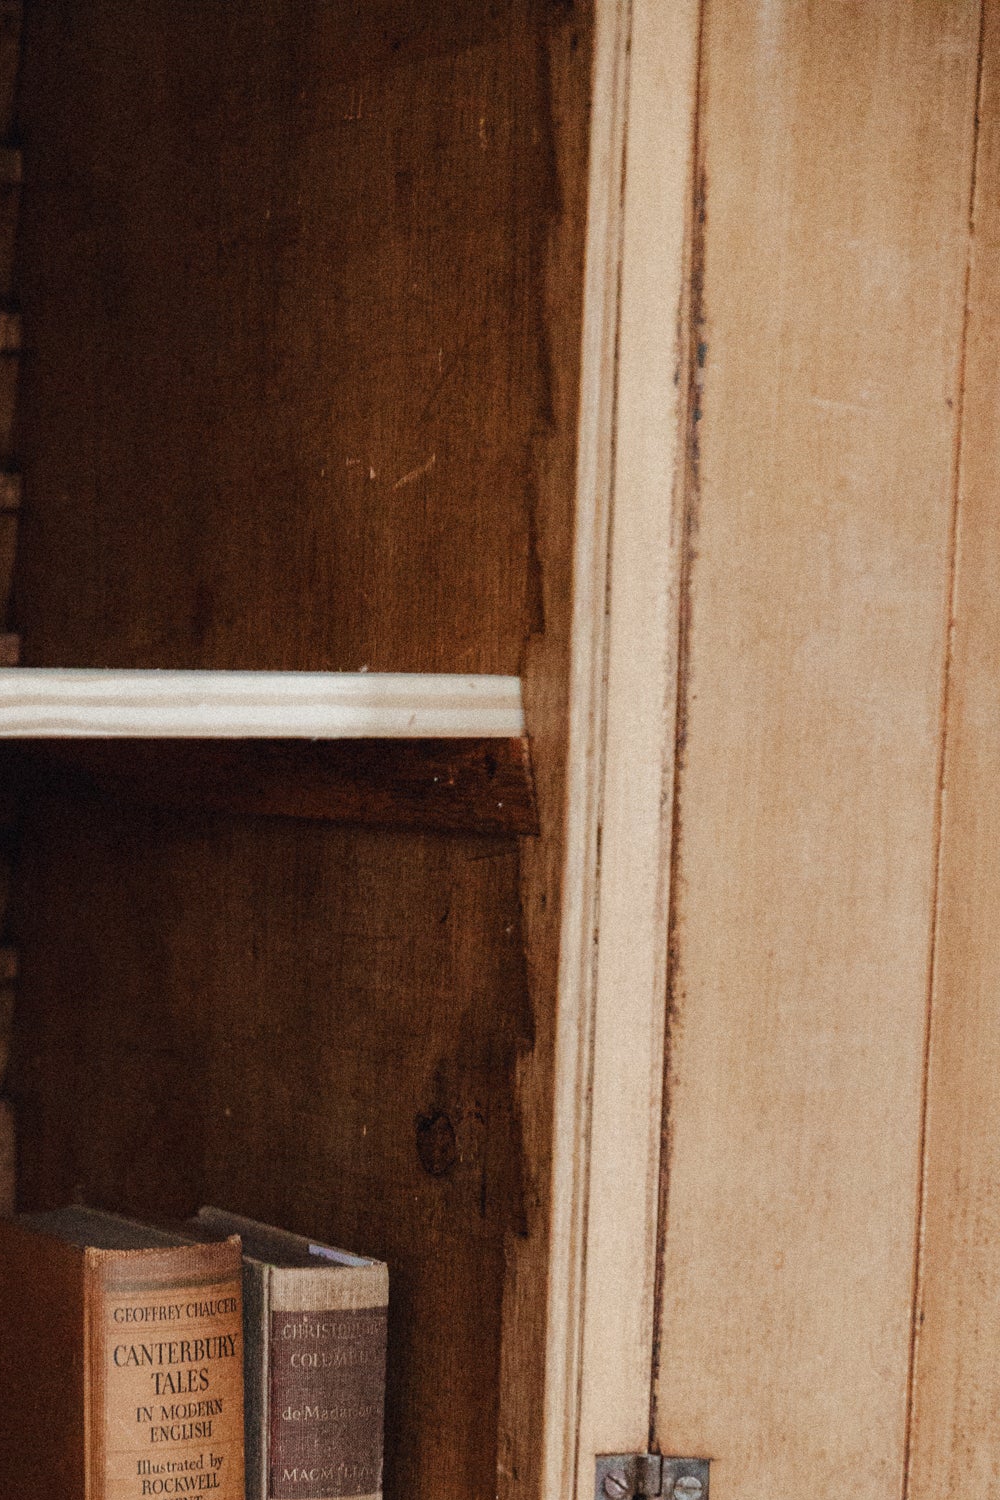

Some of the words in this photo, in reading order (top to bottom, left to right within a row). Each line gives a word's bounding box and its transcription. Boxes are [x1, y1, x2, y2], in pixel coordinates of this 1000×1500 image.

[113, 1304, 184, 1323] GEOFFREY
[186, 1298, 237, 1319] CHAUCER
[113, 1333, 238, 1368] CANTERBURY
[290, 1350, 378, 1369] COLUMBU
[150, 1367, 210, 1396] TALES
[136, 1405, 154, 1423] IN
[161, 1399, 223, 1421] MODERN
[150, 1420, 213, 1443] ENGLISH
[136, 1454, 204, 1476] Illustrated
[209, 1453, 224, 1471] by
[141, 1472, 220, 1496] ROCKWELL
